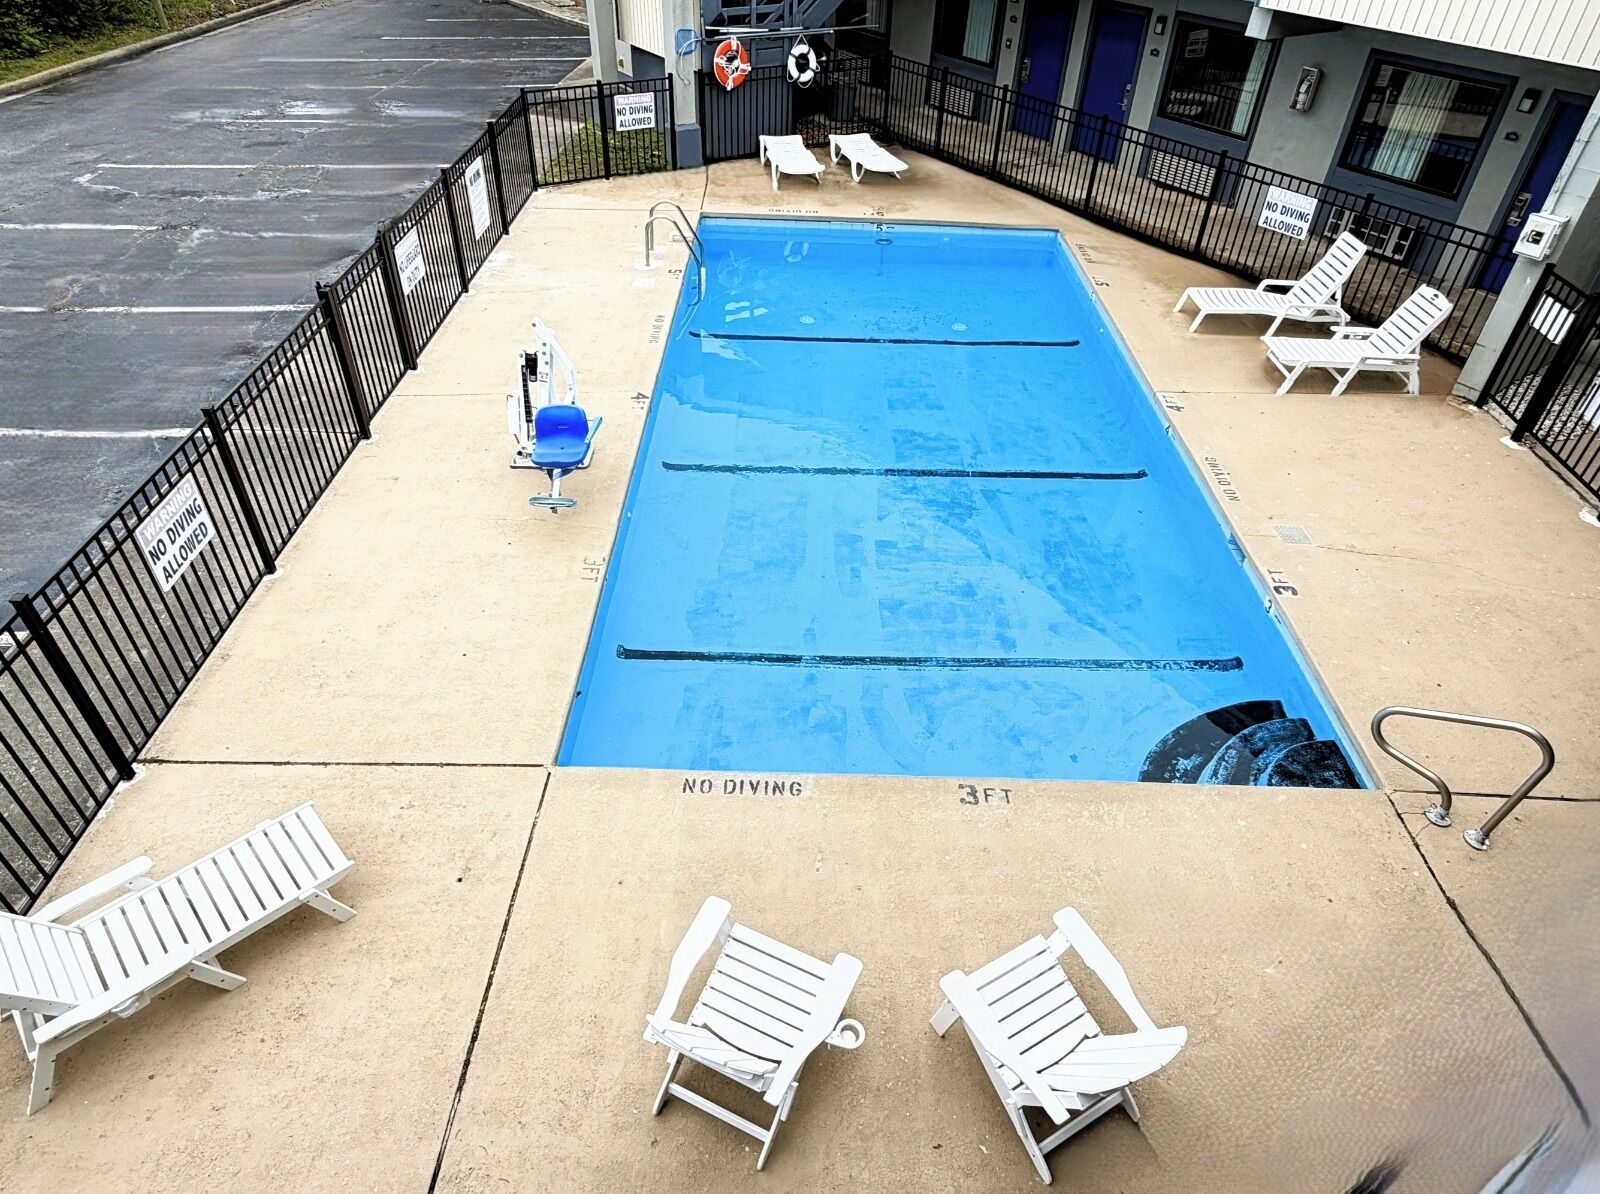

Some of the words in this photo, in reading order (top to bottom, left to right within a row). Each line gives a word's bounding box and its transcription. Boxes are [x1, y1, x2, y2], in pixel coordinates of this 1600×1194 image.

[617, 107, 626, 116] NO
[629, 105, 653, 115] DIVING
[620, 117, 651, 128] ALLOWED
[1265, 200, 1279, 213] NO
[1280, 205, 1310, 223] DIVING
[1263, 215, 1303, 237] ALLOWED
[1204, 456, 1232, 486] DIVING
[1223, 489, 1240, 502] NO
[142, 484, 193, 541] WARNING
[148, 538, 167, 566] NO
[165, 497, 203, 546] DIVING
[162, 521, 209, 585] ALLOWED
[1267, 568, 1298, 596] 3FT
[682, 778, 713, 794] NO
[722, 779, 803, 796] DIVING
[958, 783, 1013, 806] 3FT
